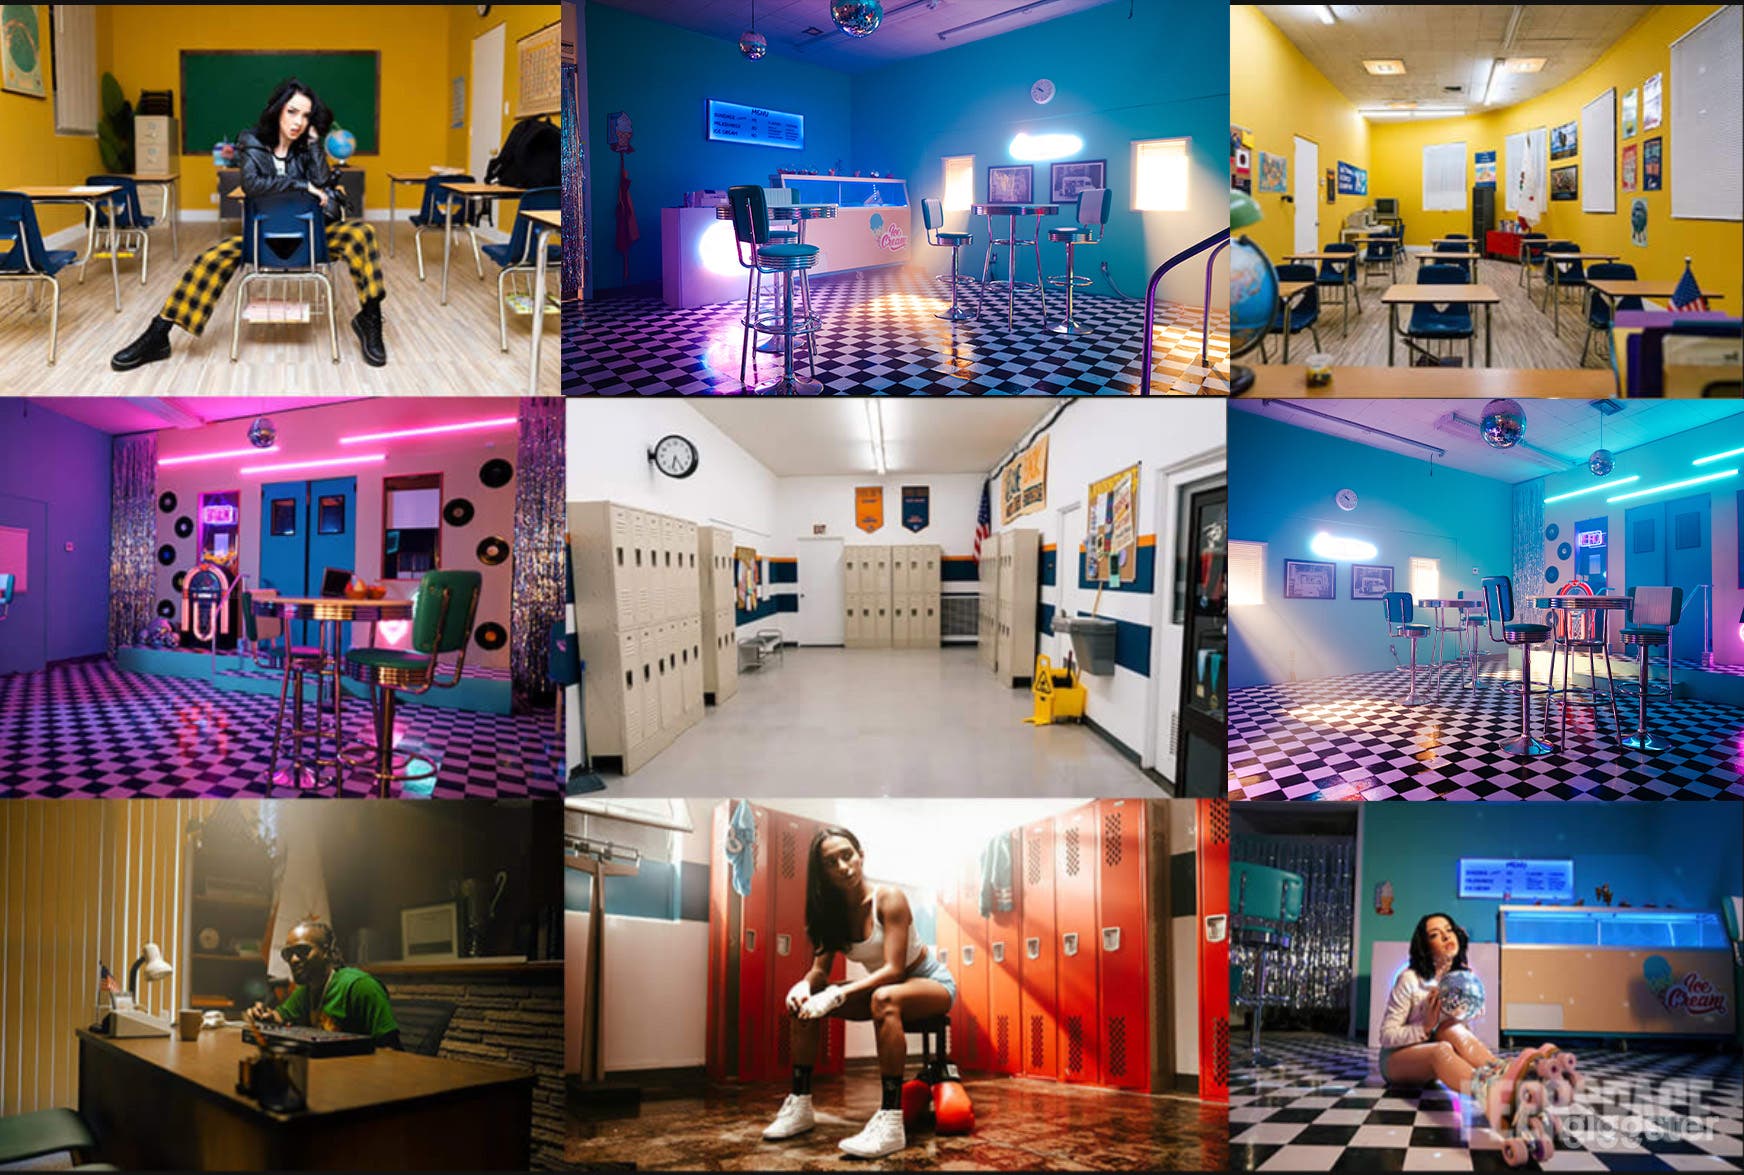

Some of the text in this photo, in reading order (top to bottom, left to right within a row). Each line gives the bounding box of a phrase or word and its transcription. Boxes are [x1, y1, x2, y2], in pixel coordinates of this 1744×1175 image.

[889, 224, 902, 236] Ice
[882, 234, 907, 250] Cream
[1684, 973, 1713, 994] Ice
[1667, 986, 1728, 1015] Cream
